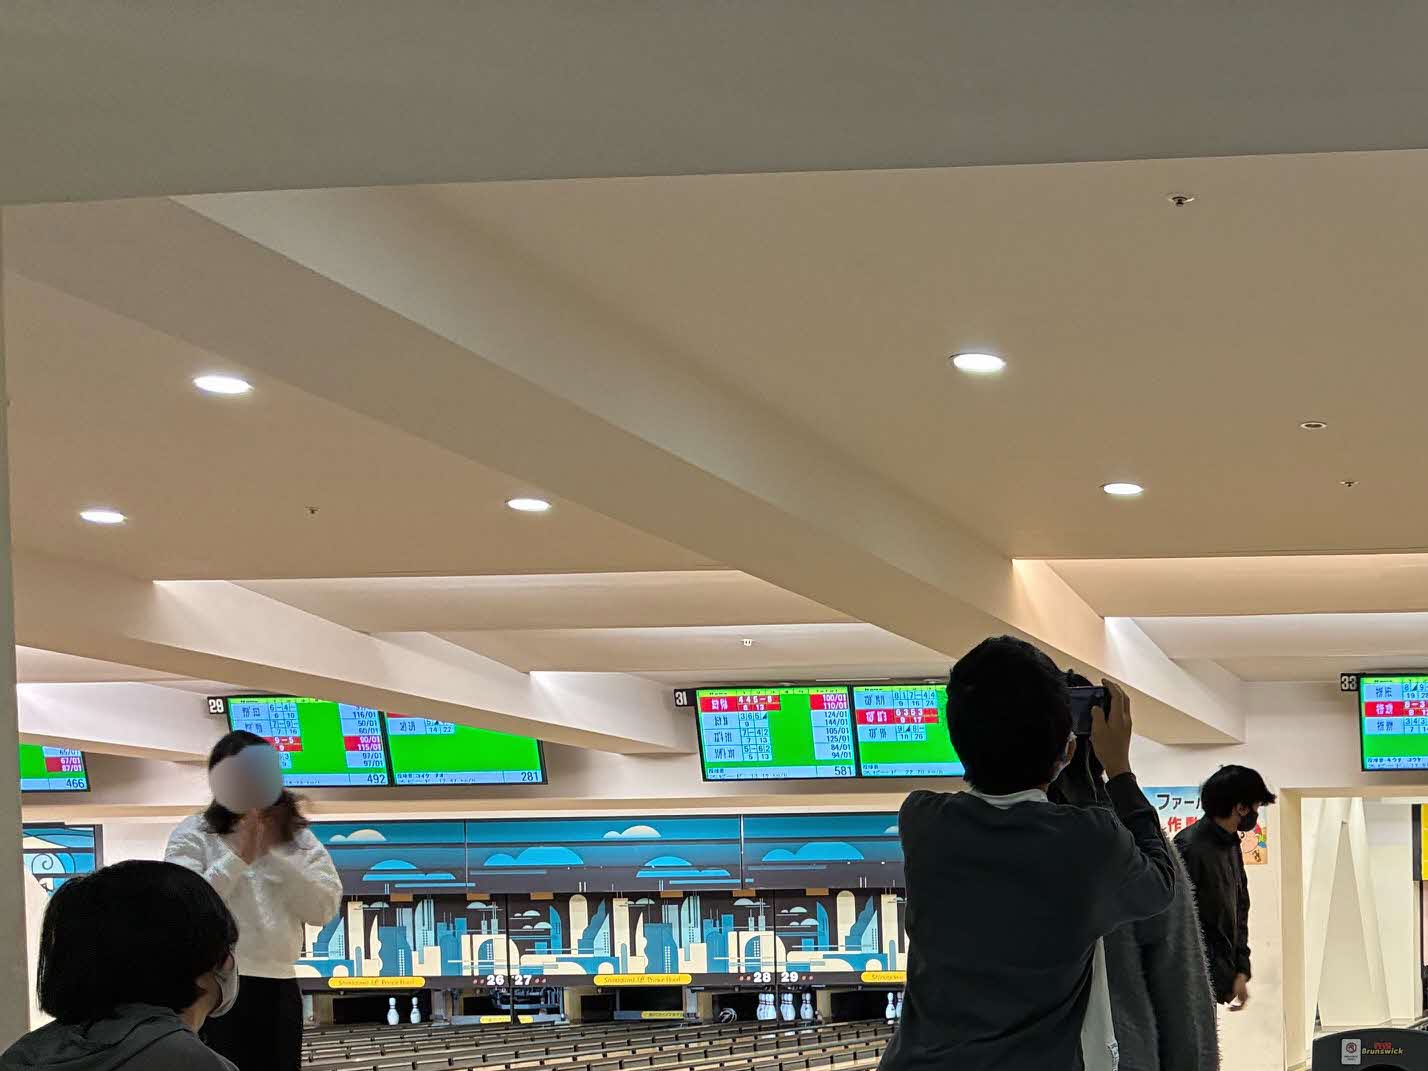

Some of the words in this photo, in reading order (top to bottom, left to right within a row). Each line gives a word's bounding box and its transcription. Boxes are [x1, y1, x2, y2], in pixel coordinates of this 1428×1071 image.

[1341, 676, 1357, 690] 33
[676, 691, 687, 705] 31
[835, 766, 852, 775] 581
[367, 774, 386, 783] 492
[520, 772, 539, 782] 281
[66, 779, 85, 788] 466
[487, 975, 505, 985] 26
[514, 975, 532, 985] 27
[754, 972, 771, 982] 28
[781, 972, 798, 982] 29
